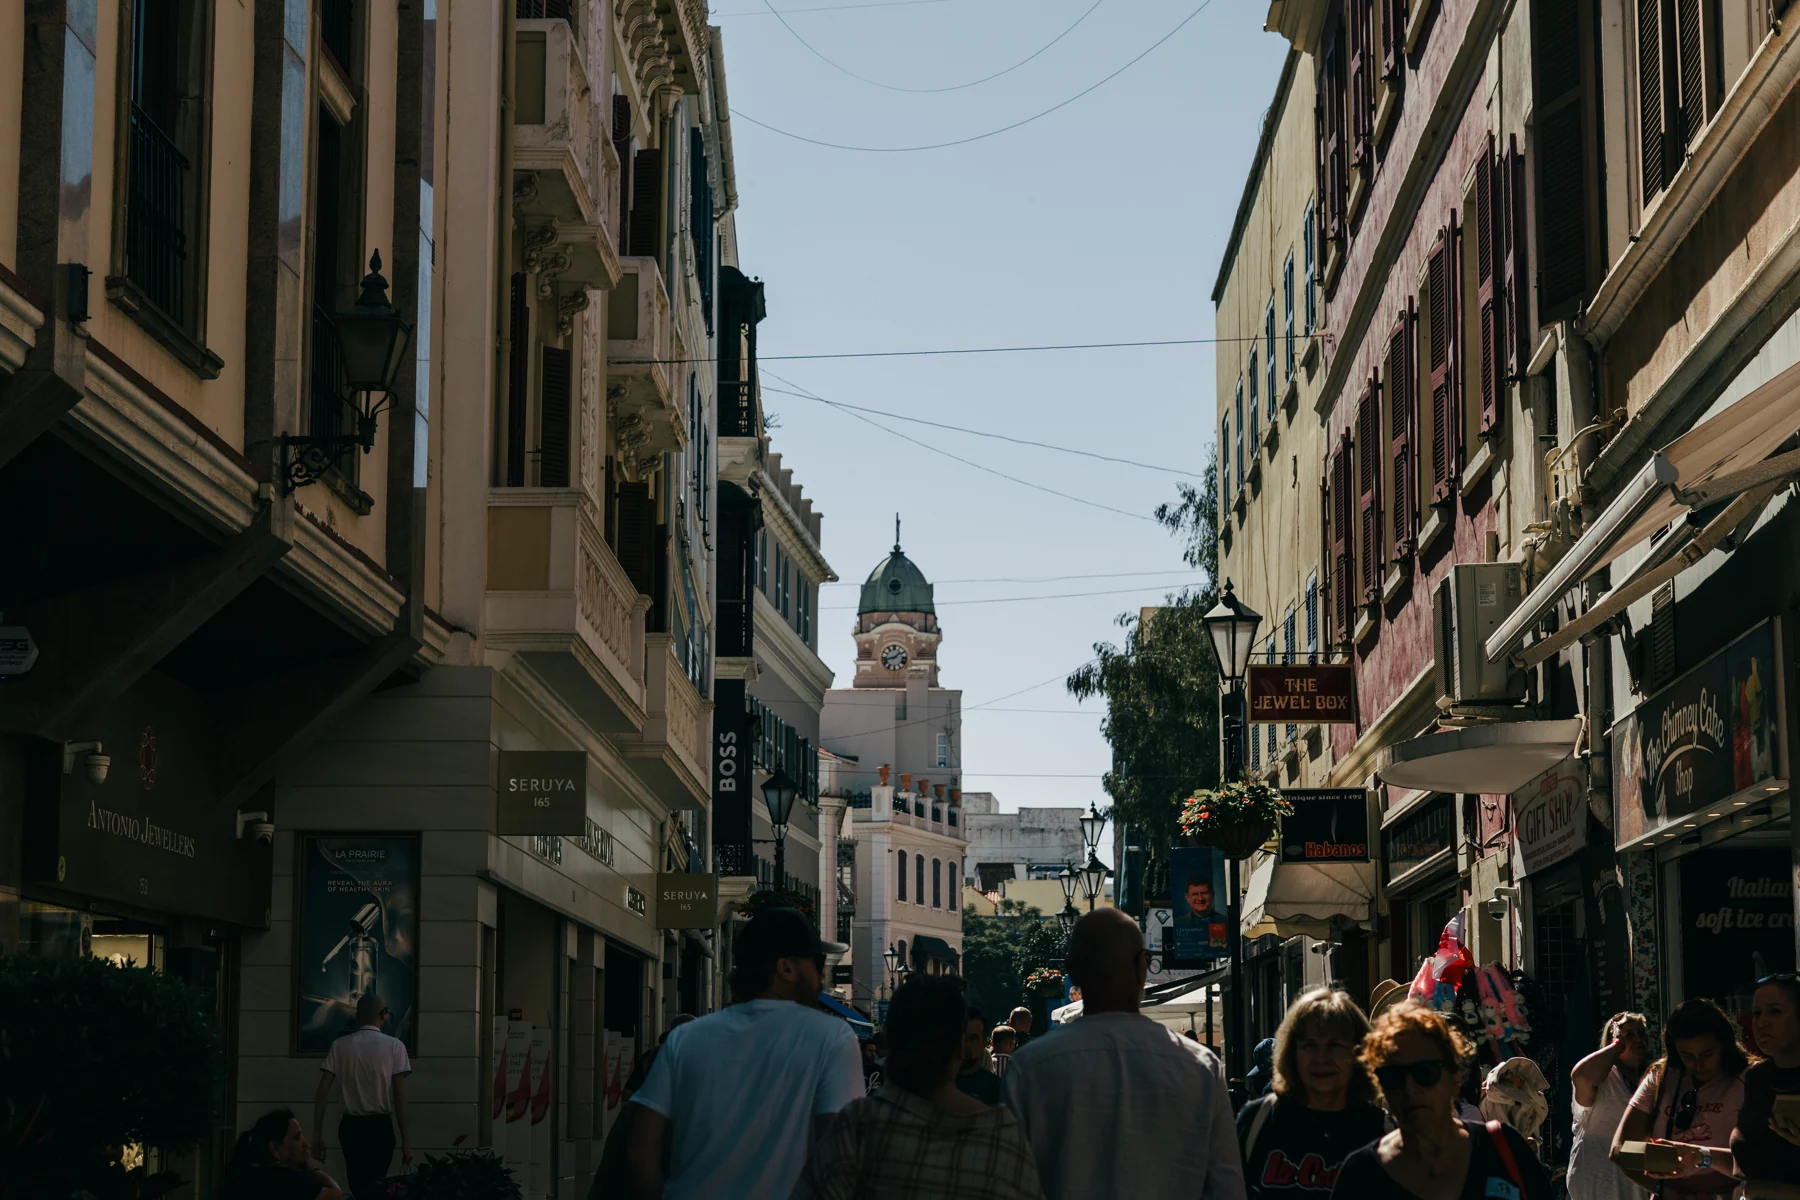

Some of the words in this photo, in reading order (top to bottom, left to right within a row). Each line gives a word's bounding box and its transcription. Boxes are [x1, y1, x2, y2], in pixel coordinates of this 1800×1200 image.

[1284, 678, 1317, 692] THE
[1253, 695, 1310, 710] JEWEL
[1315, 695, 1348, 710] BOX
[1647, 737, 1661, 786] The
[1662, 700, 1698, 754] Chimney
[1700, 687, 1724, 748] Cake
[719, 731, 737, 792] BOSS
[508, 778, 576, 792] SERUYA
[1675, 760, 1693, 804] Shop
[534, 797, 550, 808] 165
[1526, 802, 1546, 845] GIFT
[1549, 785, 1573, 834] SHOP
[88, 800, 140, 840] ANTONIO
[141, 817, 195, 858] JEWELLERS
[335, 850, 346, 858] LA
[349, 850, 386, 858] PRAIRIE
[1304, 841, 1366, 858] Habanos
[663, 891, 708, 901] SERUYA
[680, 903, 691, 911] 165
[1695, 906, 1735, 935] soft
[1736, 908, 1764, 928] ice
